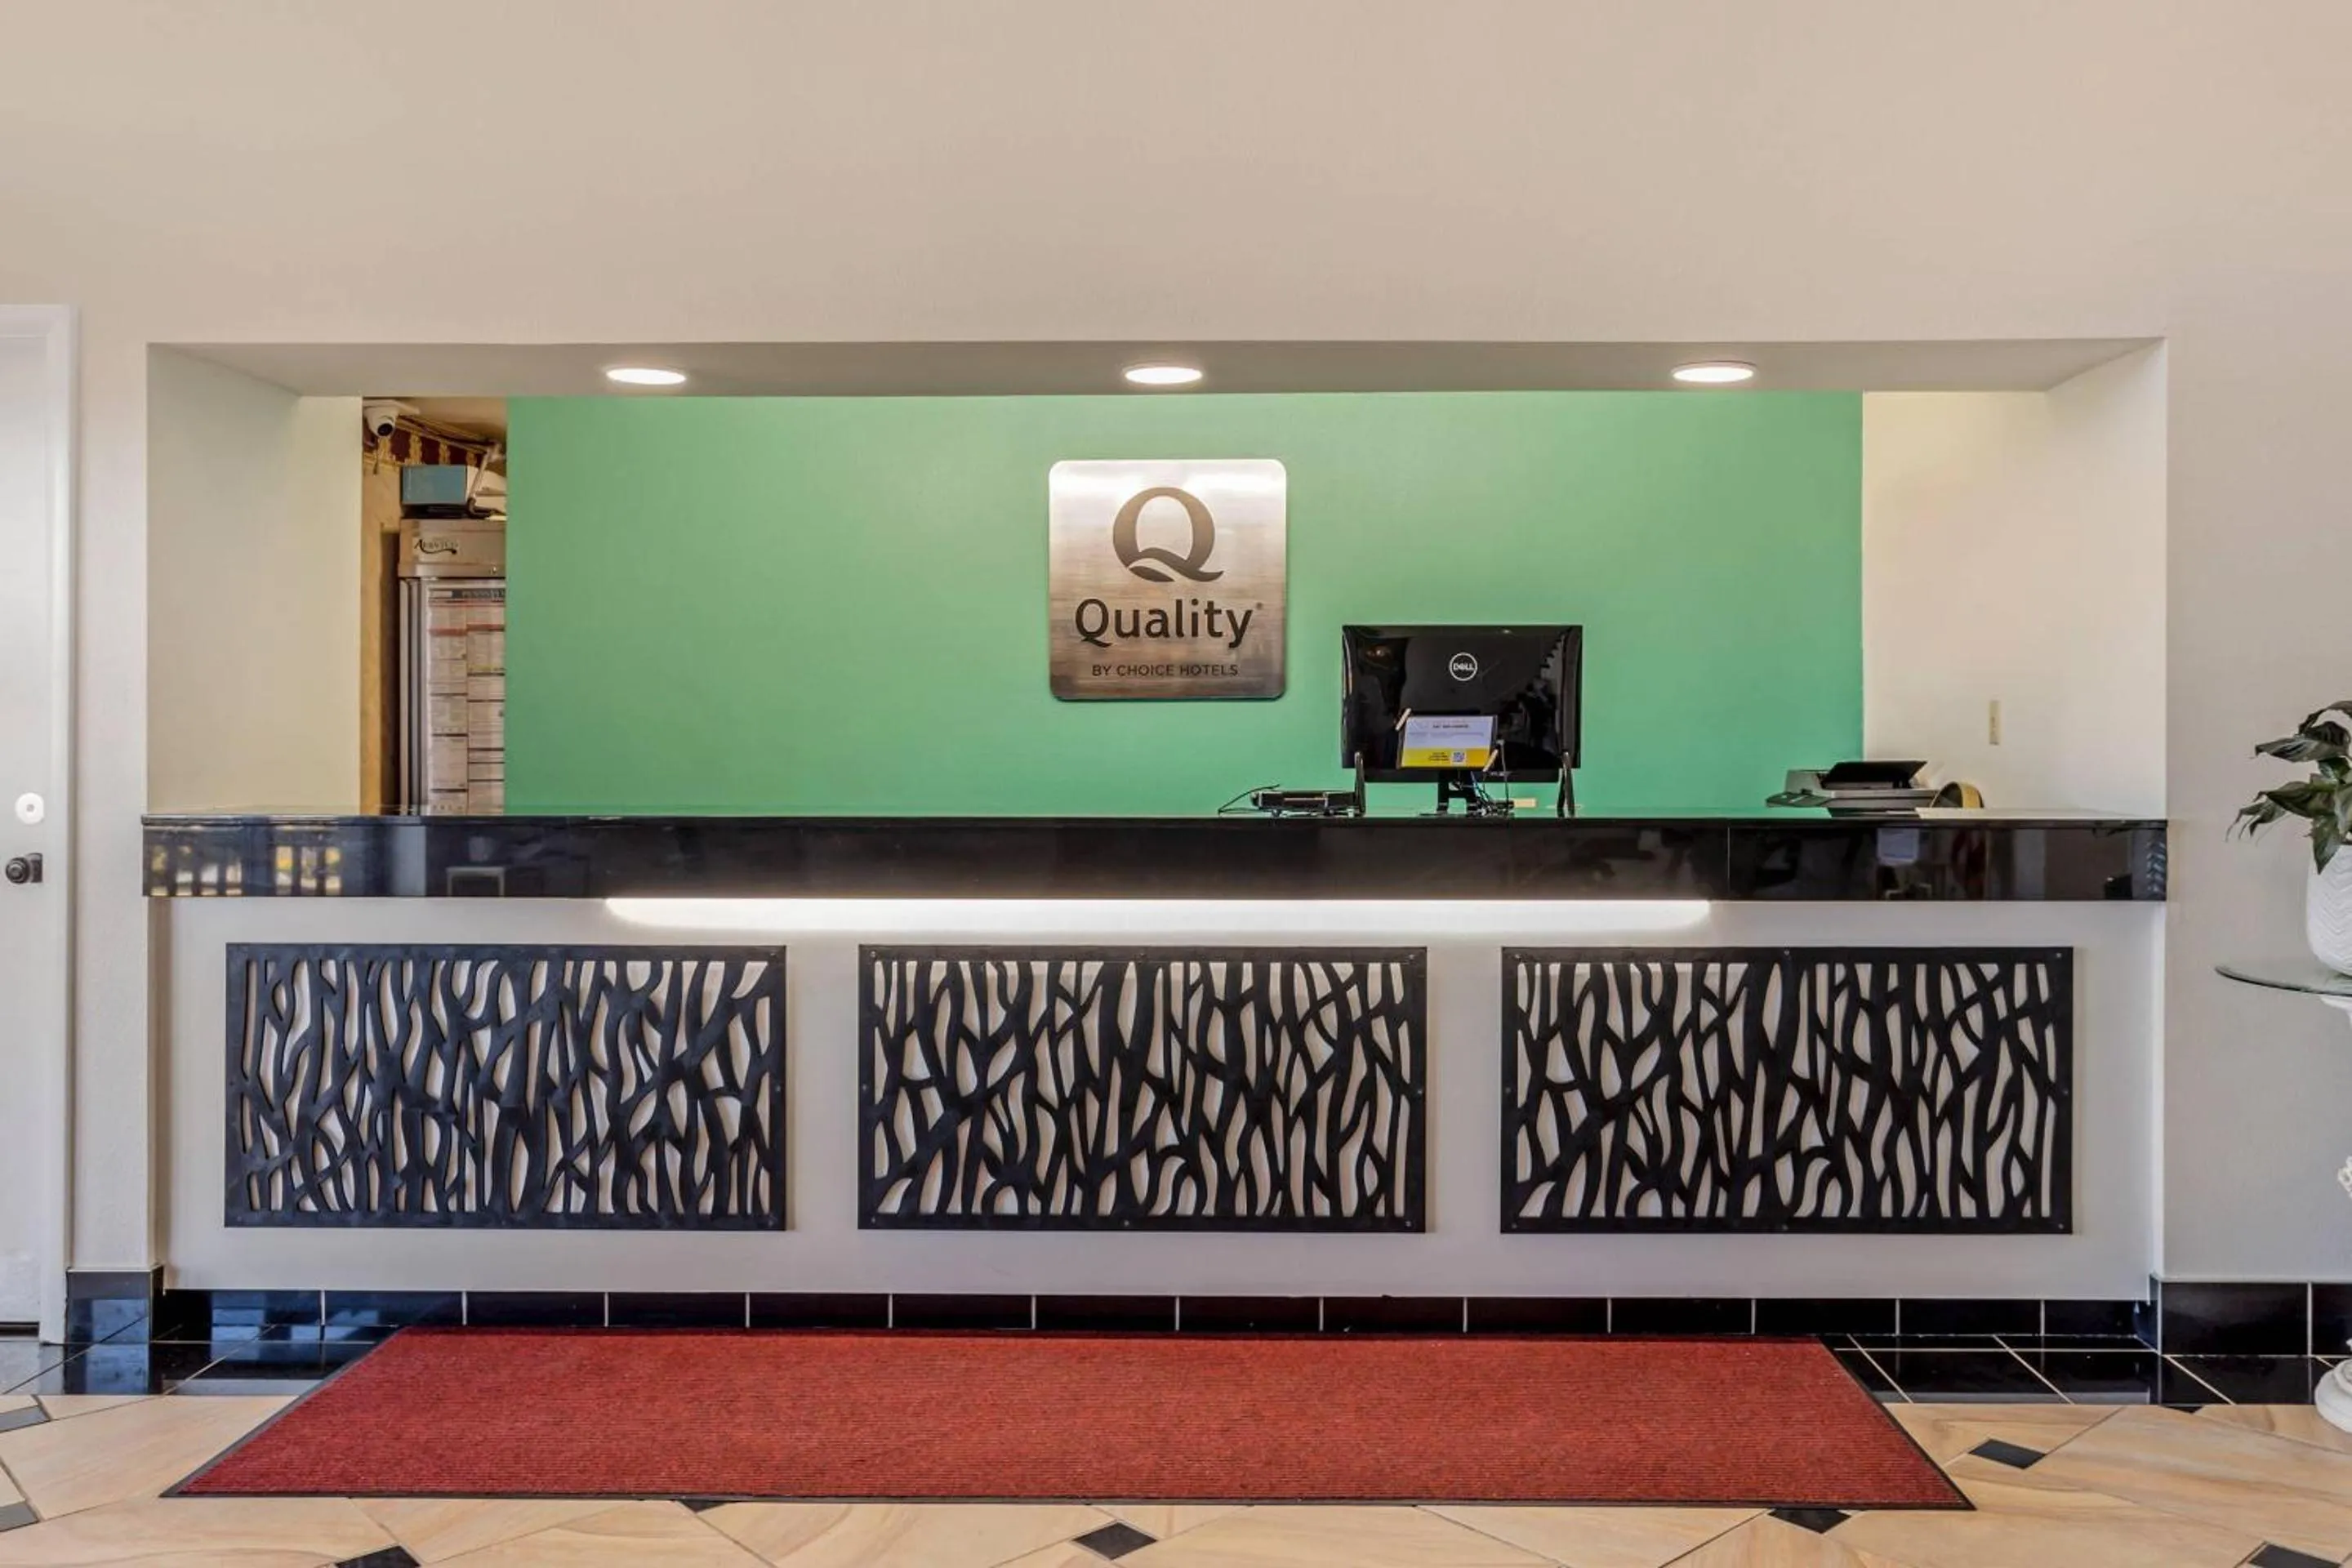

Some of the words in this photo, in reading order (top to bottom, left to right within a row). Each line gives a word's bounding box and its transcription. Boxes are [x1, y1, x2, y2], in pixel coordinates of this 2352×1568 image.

[1112, 486, 1224, 582] Q
[1075, 598, 1254, 648] Quality
[1091, 664, 1111, 677] BY
[1116, 664, 1174, 677] CHOICE
[1179, 664, 1239, 677] HOTELS
[1453, 662, 1475, 670] DELL
